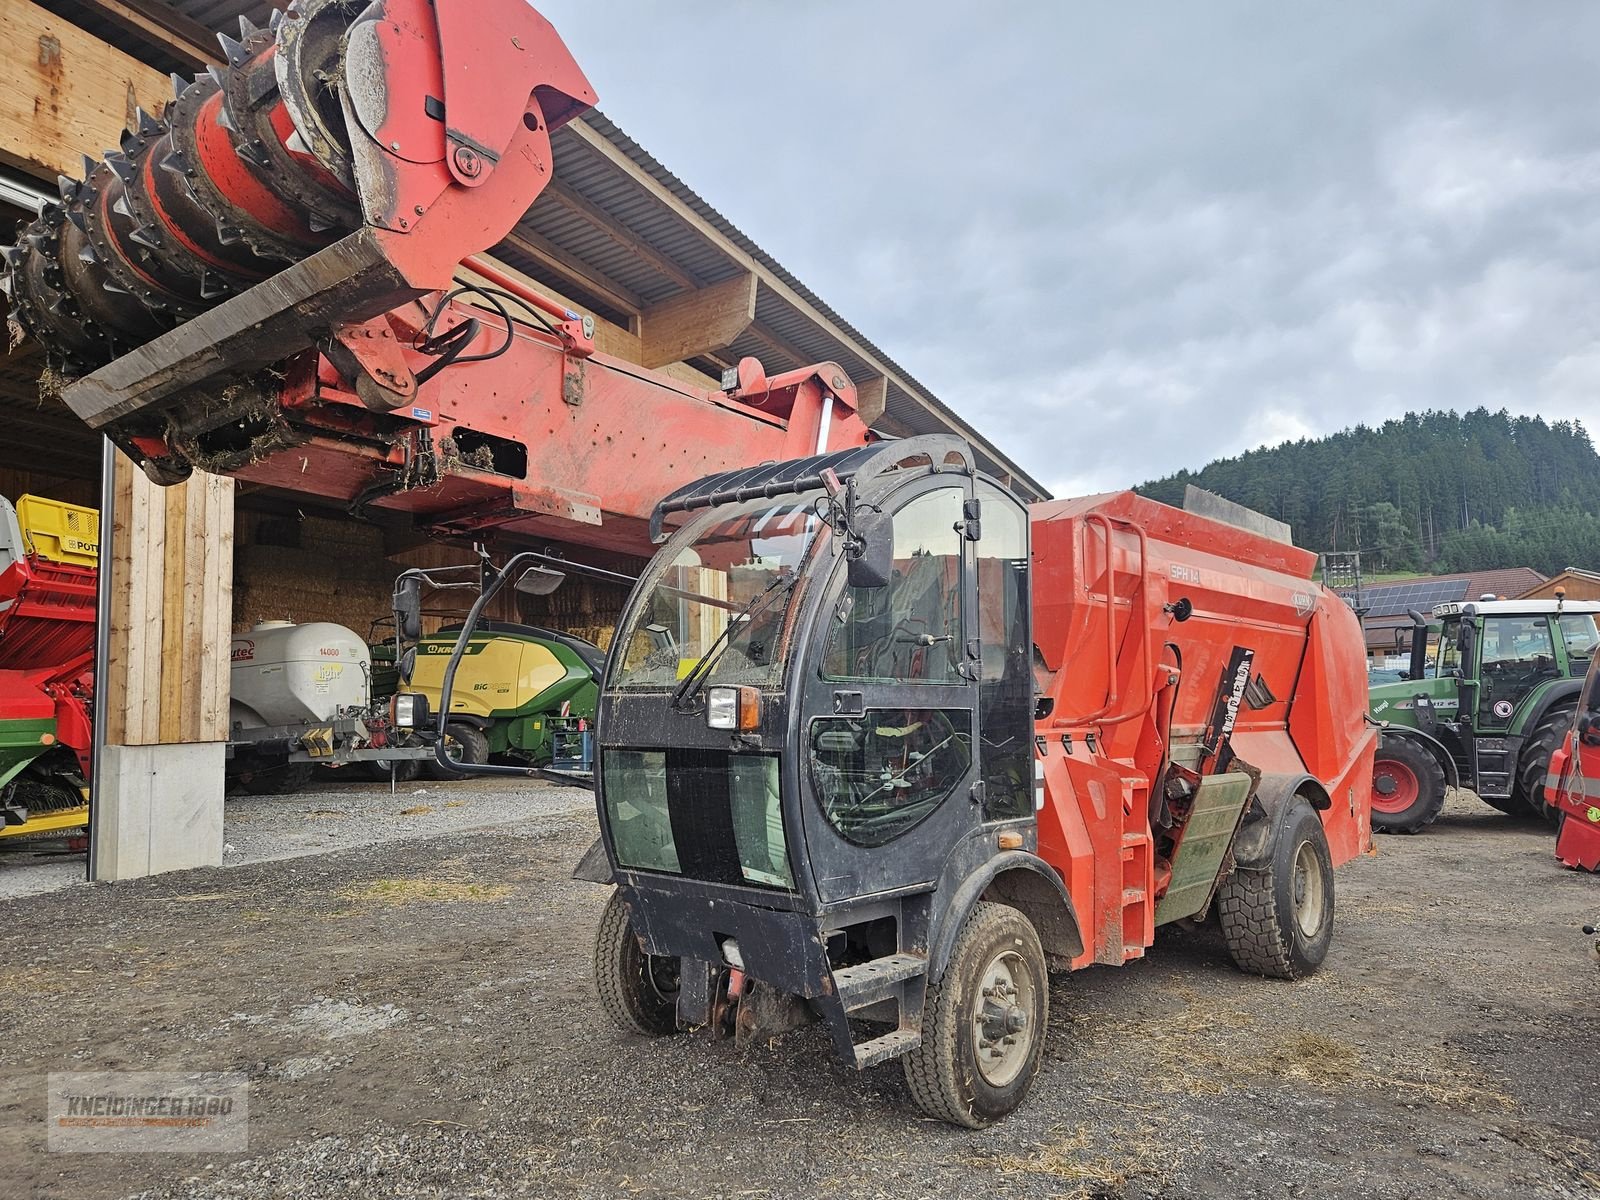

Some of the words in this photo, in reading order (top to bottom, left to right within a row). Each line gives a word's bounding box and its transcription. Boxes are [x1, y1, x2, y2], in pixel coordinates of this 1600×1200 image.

[1170, 565, 1188, 581] SPH
[1190, 568, 1199, 584] 14
[319, 647, 340, 656] 14000
